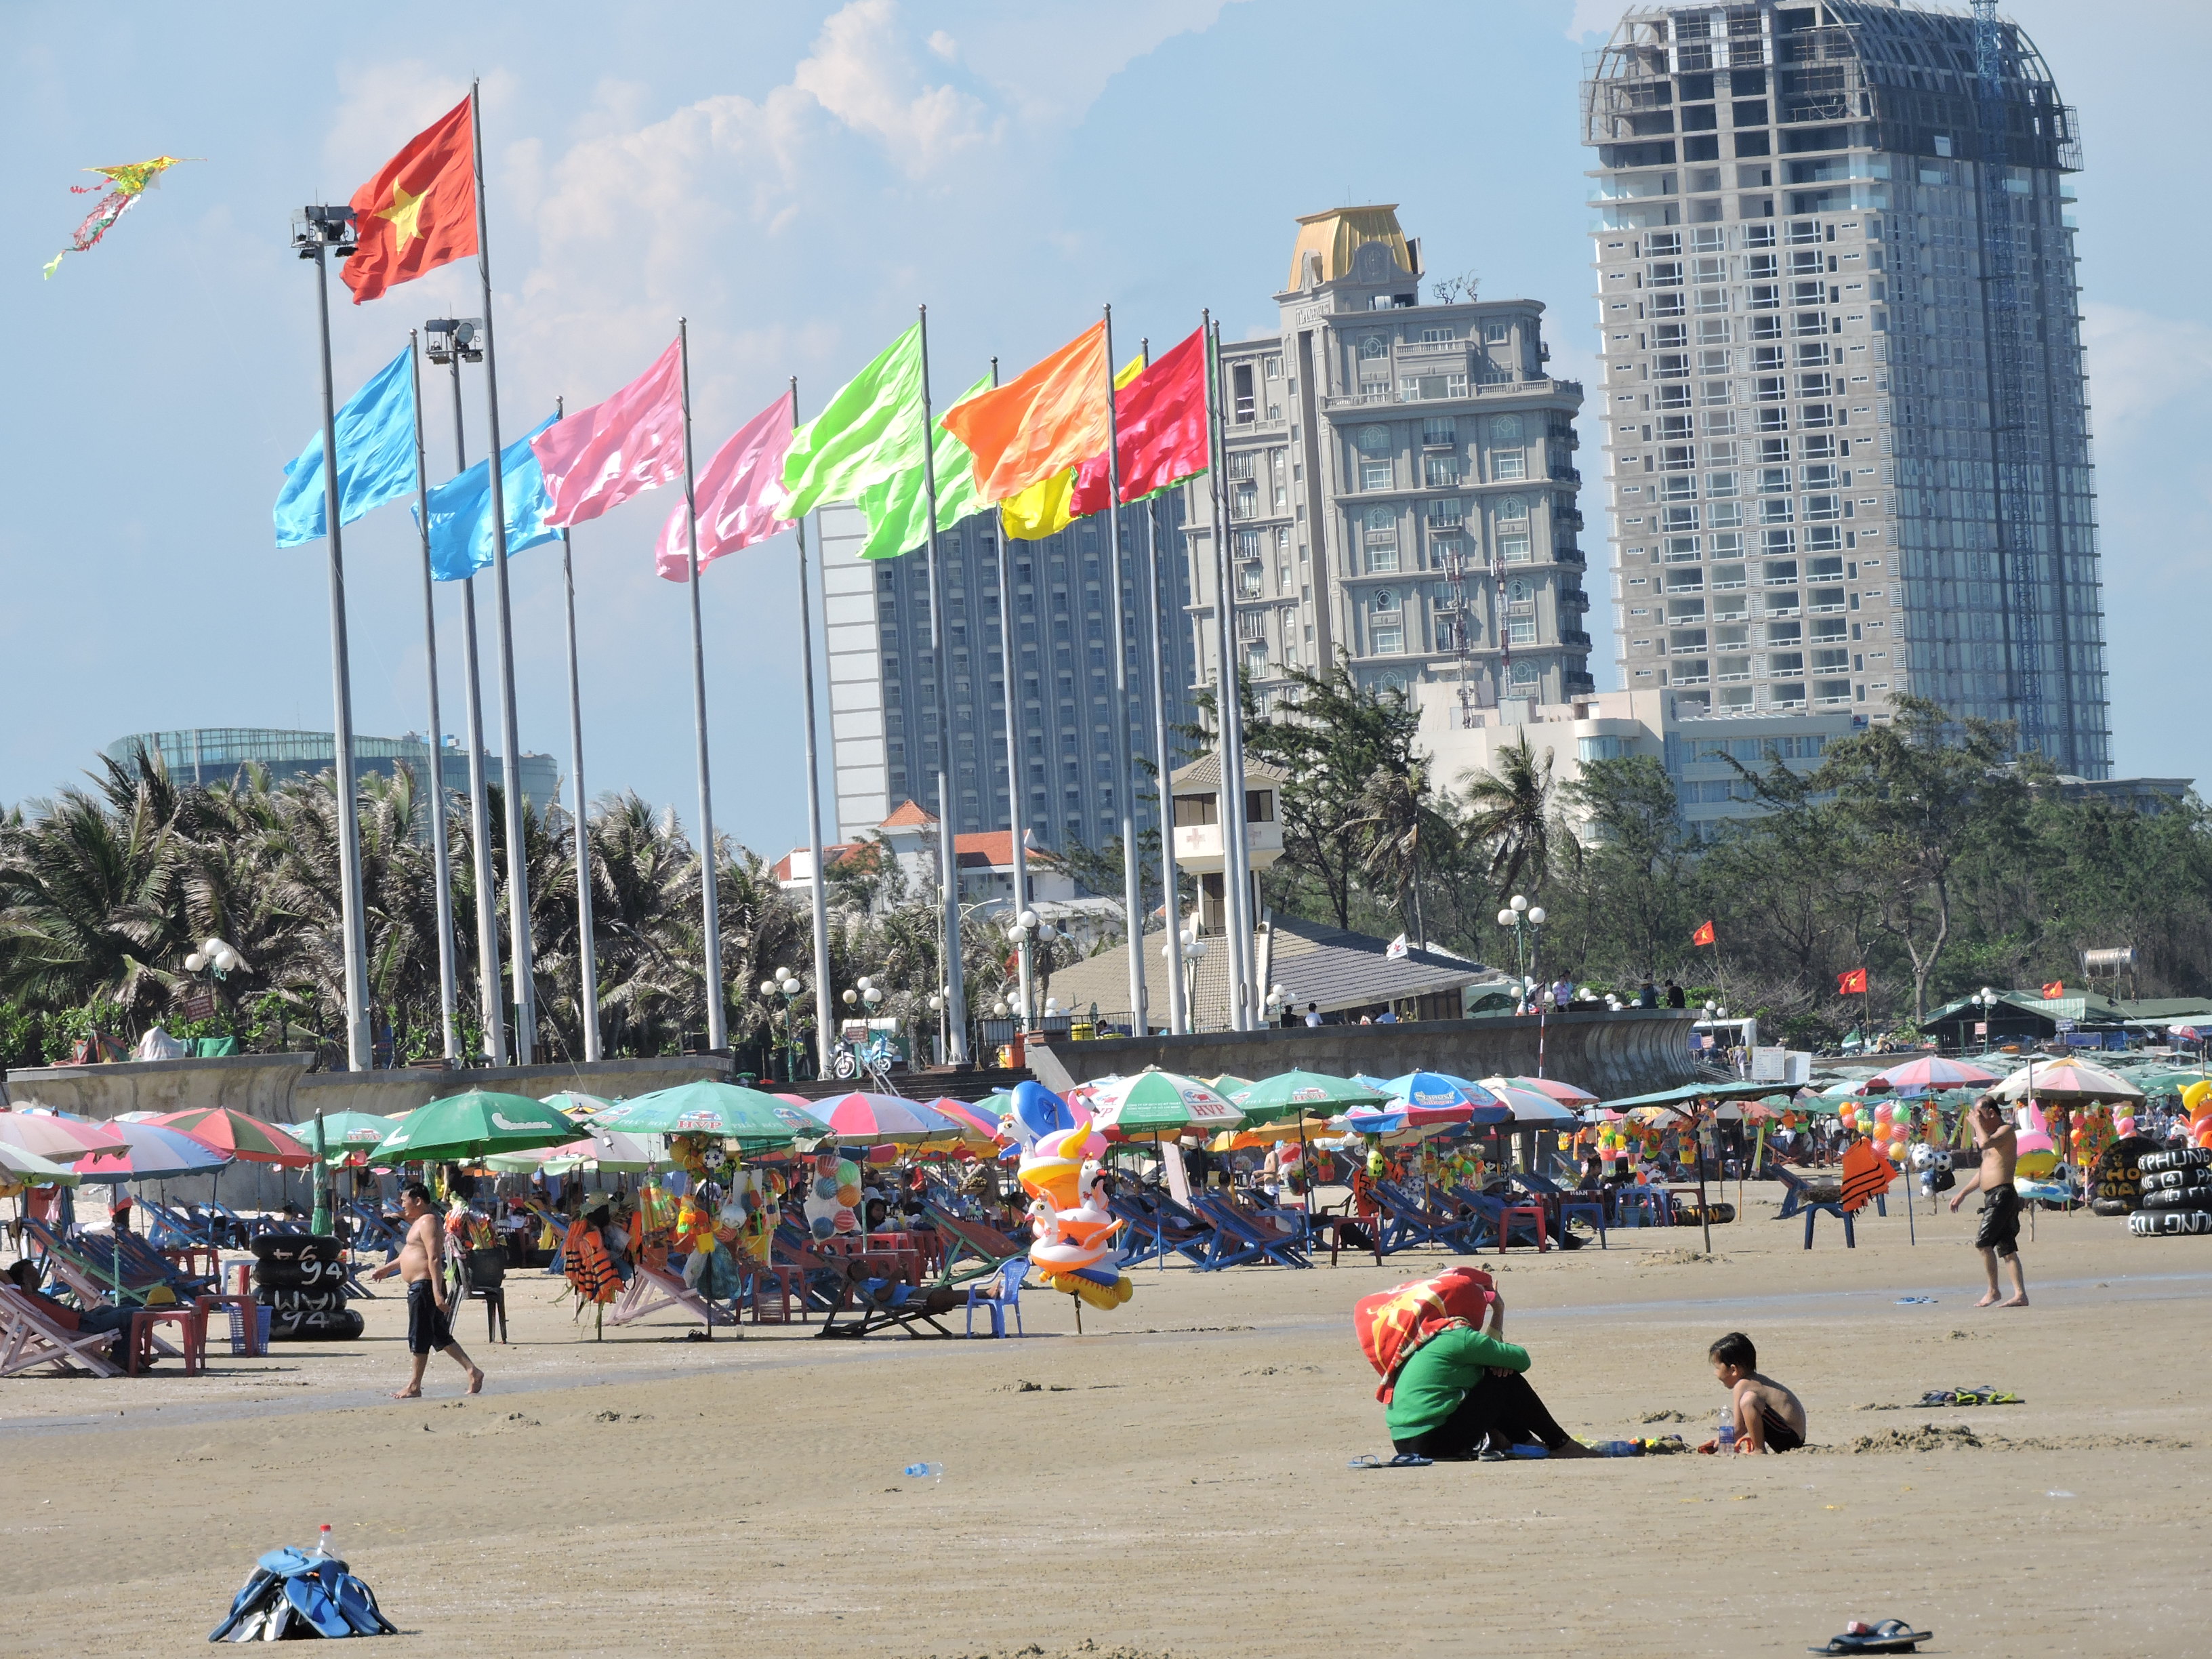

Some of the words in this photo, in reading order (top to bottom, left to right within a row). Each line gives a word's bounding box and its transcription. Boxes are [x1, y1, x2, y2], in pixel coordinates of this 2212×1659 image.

[1292, 1093, 1328, 1102] HVP
[1191, 1104, 1225, 1117] HVP
[678, 1120, 723, 1130] HVP
[301, 1261, 343, 1286] 94
[282, 1311, 329, 1331] 94
